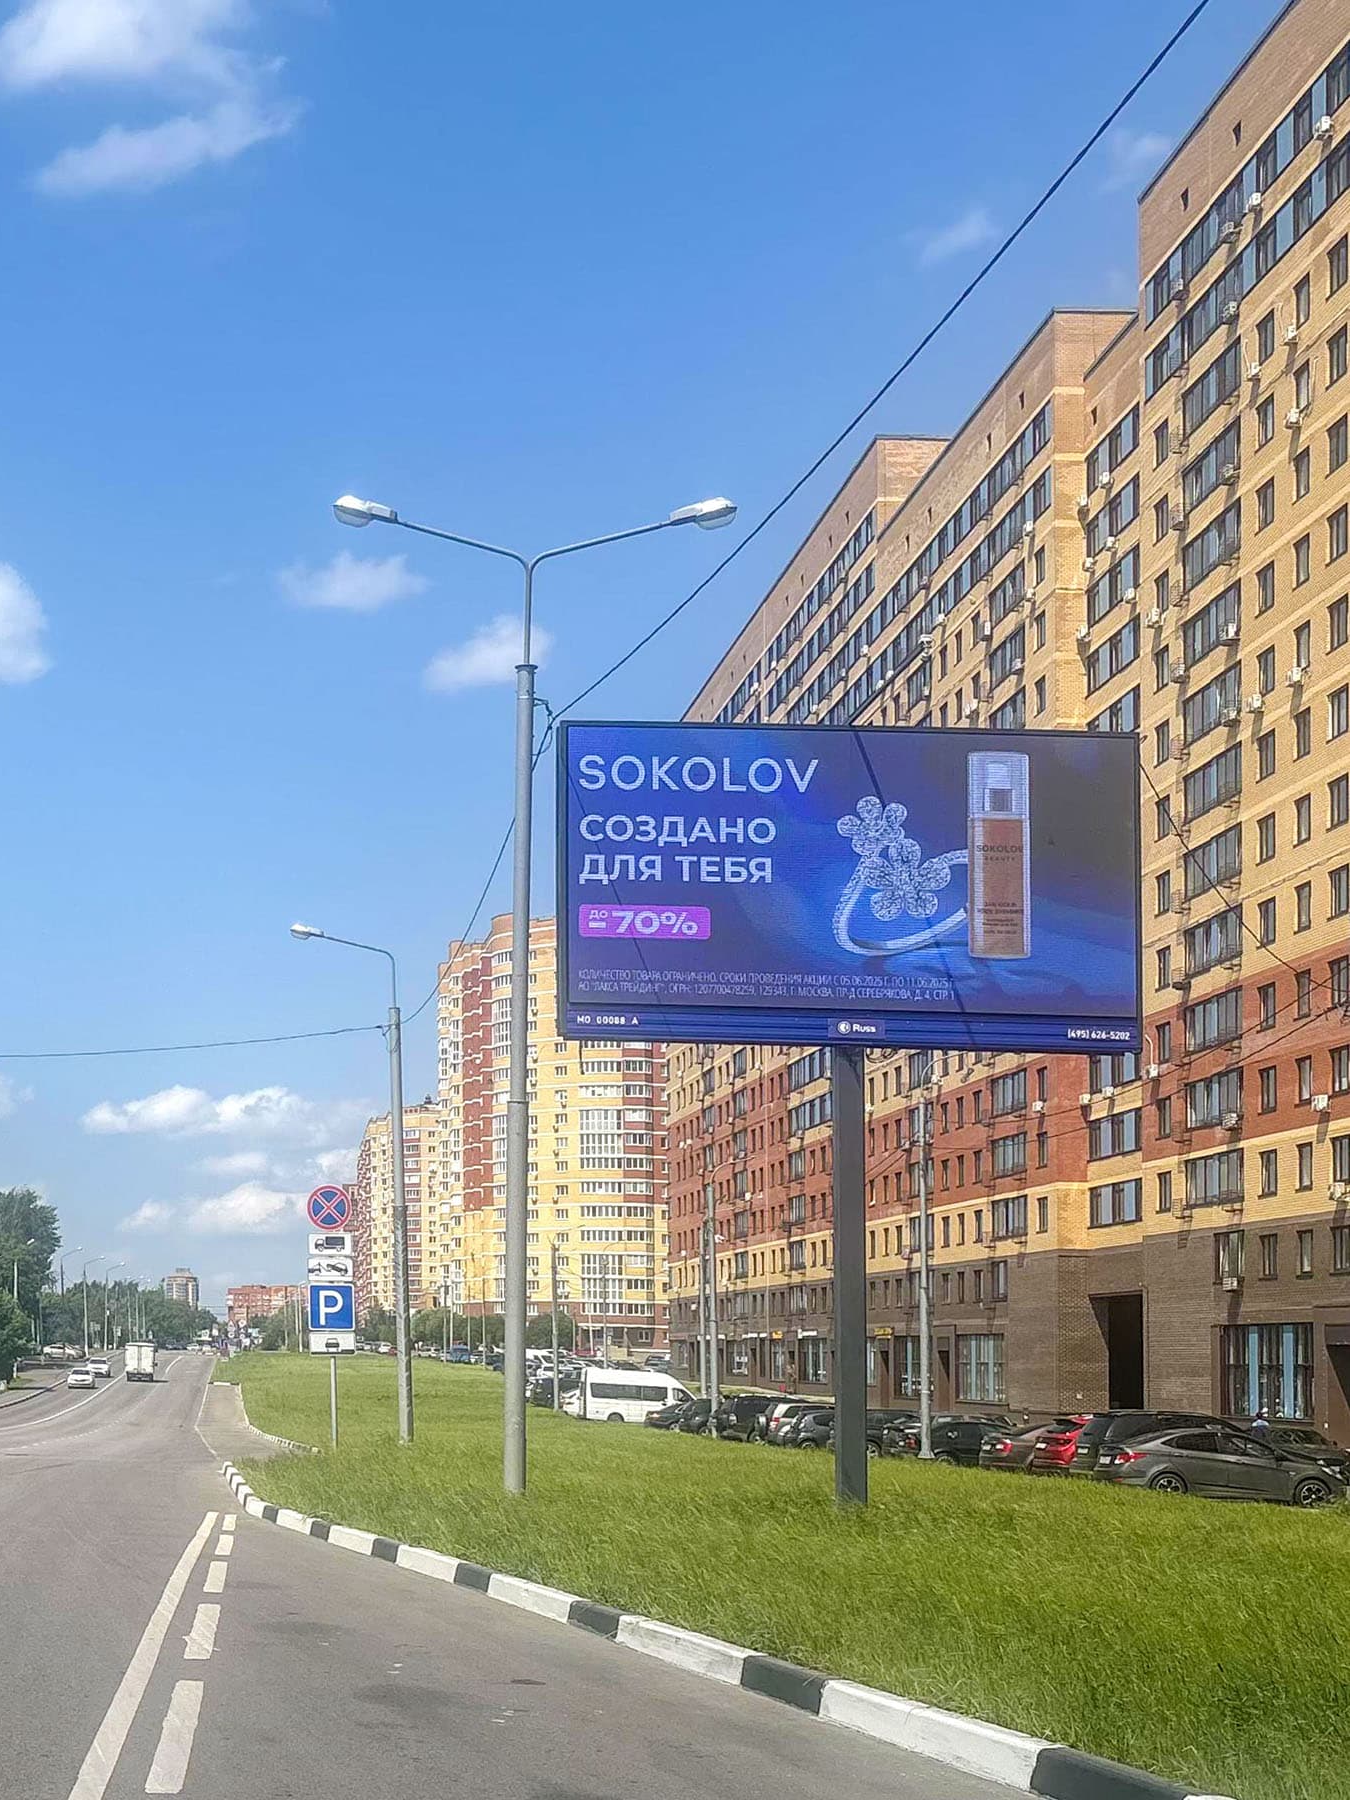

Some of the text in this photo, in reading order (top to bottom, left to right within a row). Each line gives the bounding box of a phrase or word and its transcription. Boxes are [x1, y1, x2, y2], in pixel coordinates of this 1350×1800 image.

[579, 755, 818, 793] SOKOLOV
[579, 814, 777, 847] СОЗДАНО
[579, 854, 772, 885] ДЛЯ ТЕБЯ
[632, 969, 661, 982] ТОВАРА
[719, 972, 747, 984] СРОКИ
[803, 974, 831, 987] АКЦИИ
[892, 976, 904, 988] ПО
[852, 1023, 876, 1033] Russ
[1091, 1030, 1130, 1040] 626-5202
[319, 1290, 344, 1326] P
